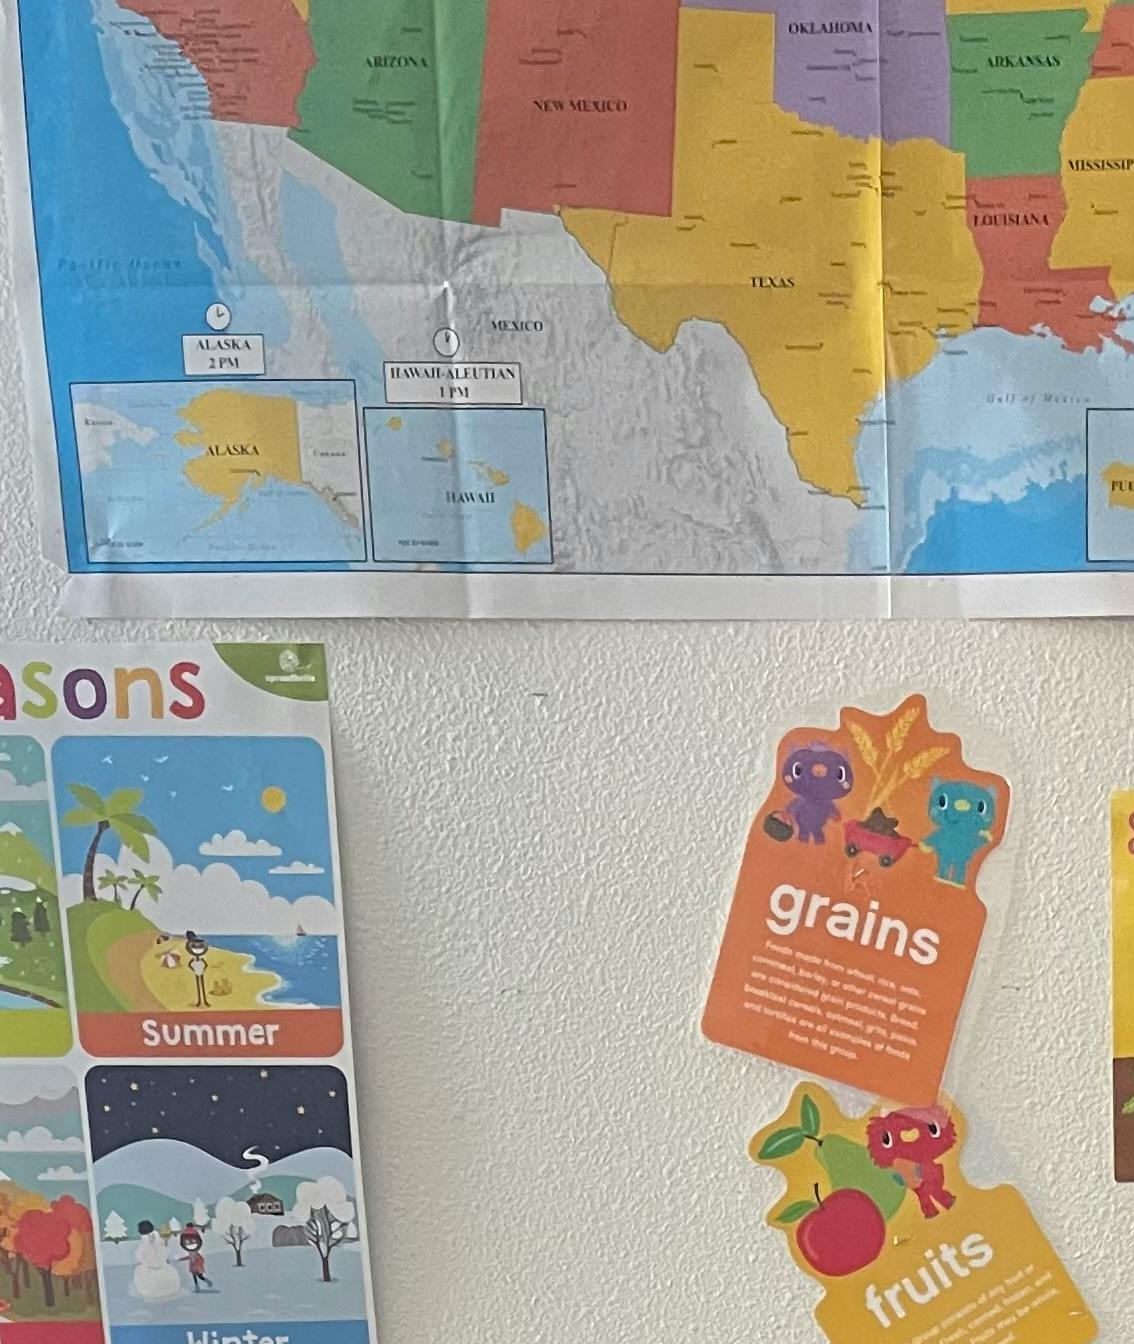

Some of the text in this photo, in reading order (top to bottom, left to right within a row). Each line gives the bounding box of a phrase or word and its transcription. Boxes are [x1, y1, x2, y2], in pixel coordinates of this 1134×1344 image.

[788, 22, 873, 34] OKLAHOMA
[365, 55, 428, 69] ARIZONA
[985, 55, 1061, 68] ARKANSAS
[533, 99, 628, 113] NEW MEXICO
[973, 213, 1050, 227] LOUISIANA
[750, 276, 795, 289] TEXAS
[491, 320, 544, 332] MEXICO
[197, 339, 251, 351] ALASKA
[208, 357, 239, 369] 2 PM
[390, 367, 515, 380] HAWAII-ALEUTIAN
[449, 387, 469, 398] PM
[206, 445, 260, 457] ALASKA
[446, 491, 495, 503] HAWAII
[765, 883, 941, 966] grains
[143, 1019, 280, 1047] Summer
[865, 1232, 994, 1328] fruits
